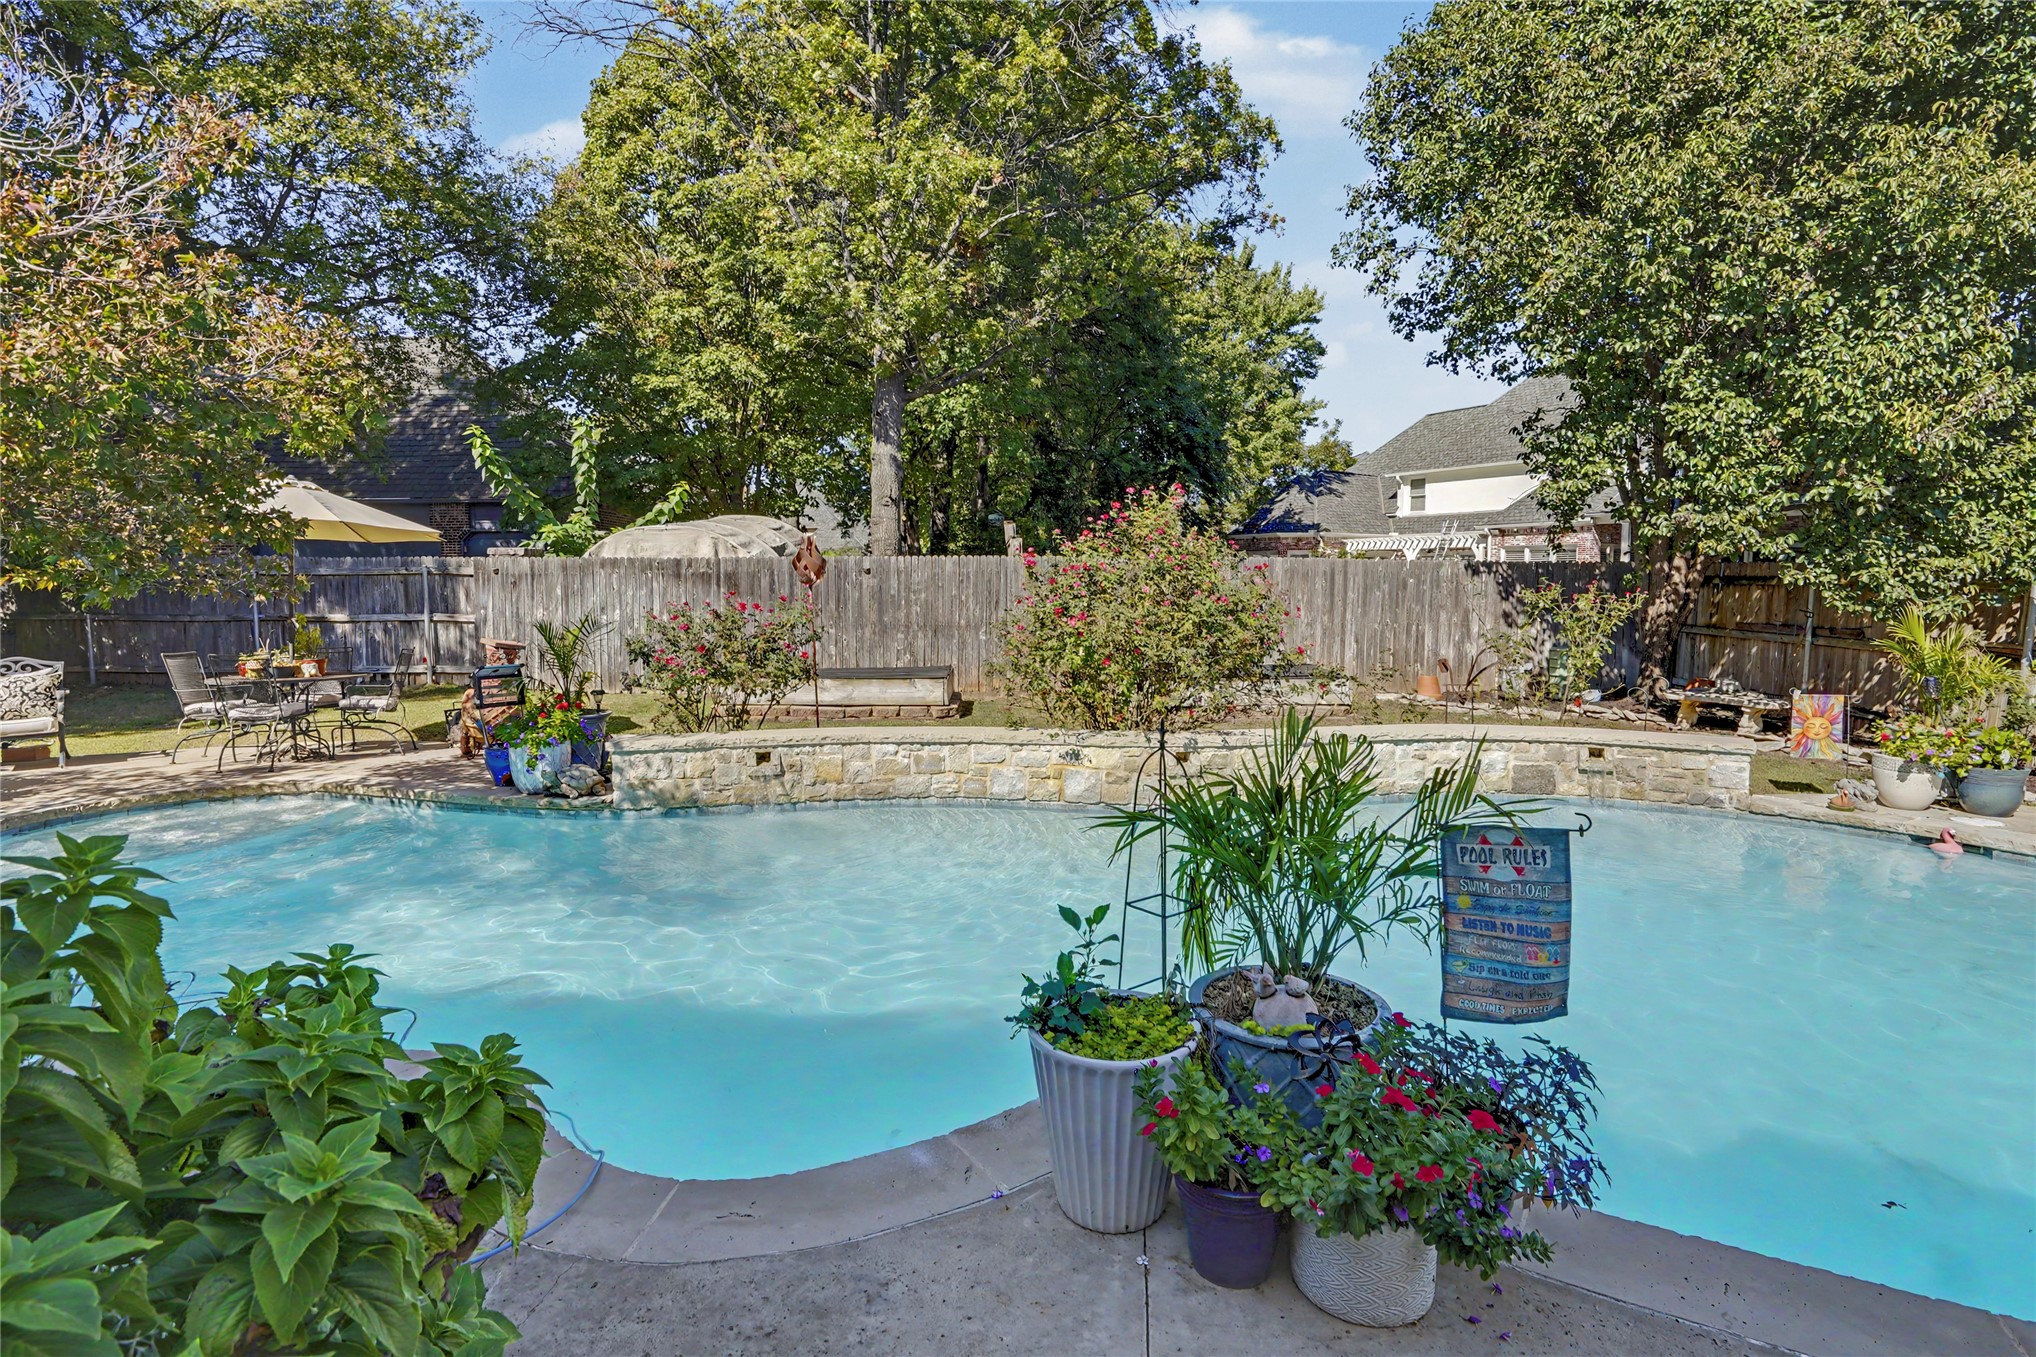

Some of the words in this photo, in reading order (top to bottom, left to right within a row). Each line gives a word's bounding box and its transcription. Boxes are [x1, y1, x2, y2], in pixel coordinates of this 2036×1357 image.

[1460, 846, 1497, 865] POOL
[1502, 847, 1548, 867] RULES
[1460, 879, 1490, 894] SWIM
[1493, 886, 1507, 896] or
[1510, 883, 1552, 899] FLOAT
[1462, 917, 1497, 932] LISTEN
[1500, 921, 1514, 935] TO
[1516, 923, 1552, 939] MUSIC
[1468, 962, 1485, 975] Sip
[1481, 1001, 1505, 1014] TIMES
[1512, 1004, 1553, 1015] EXPECTED
